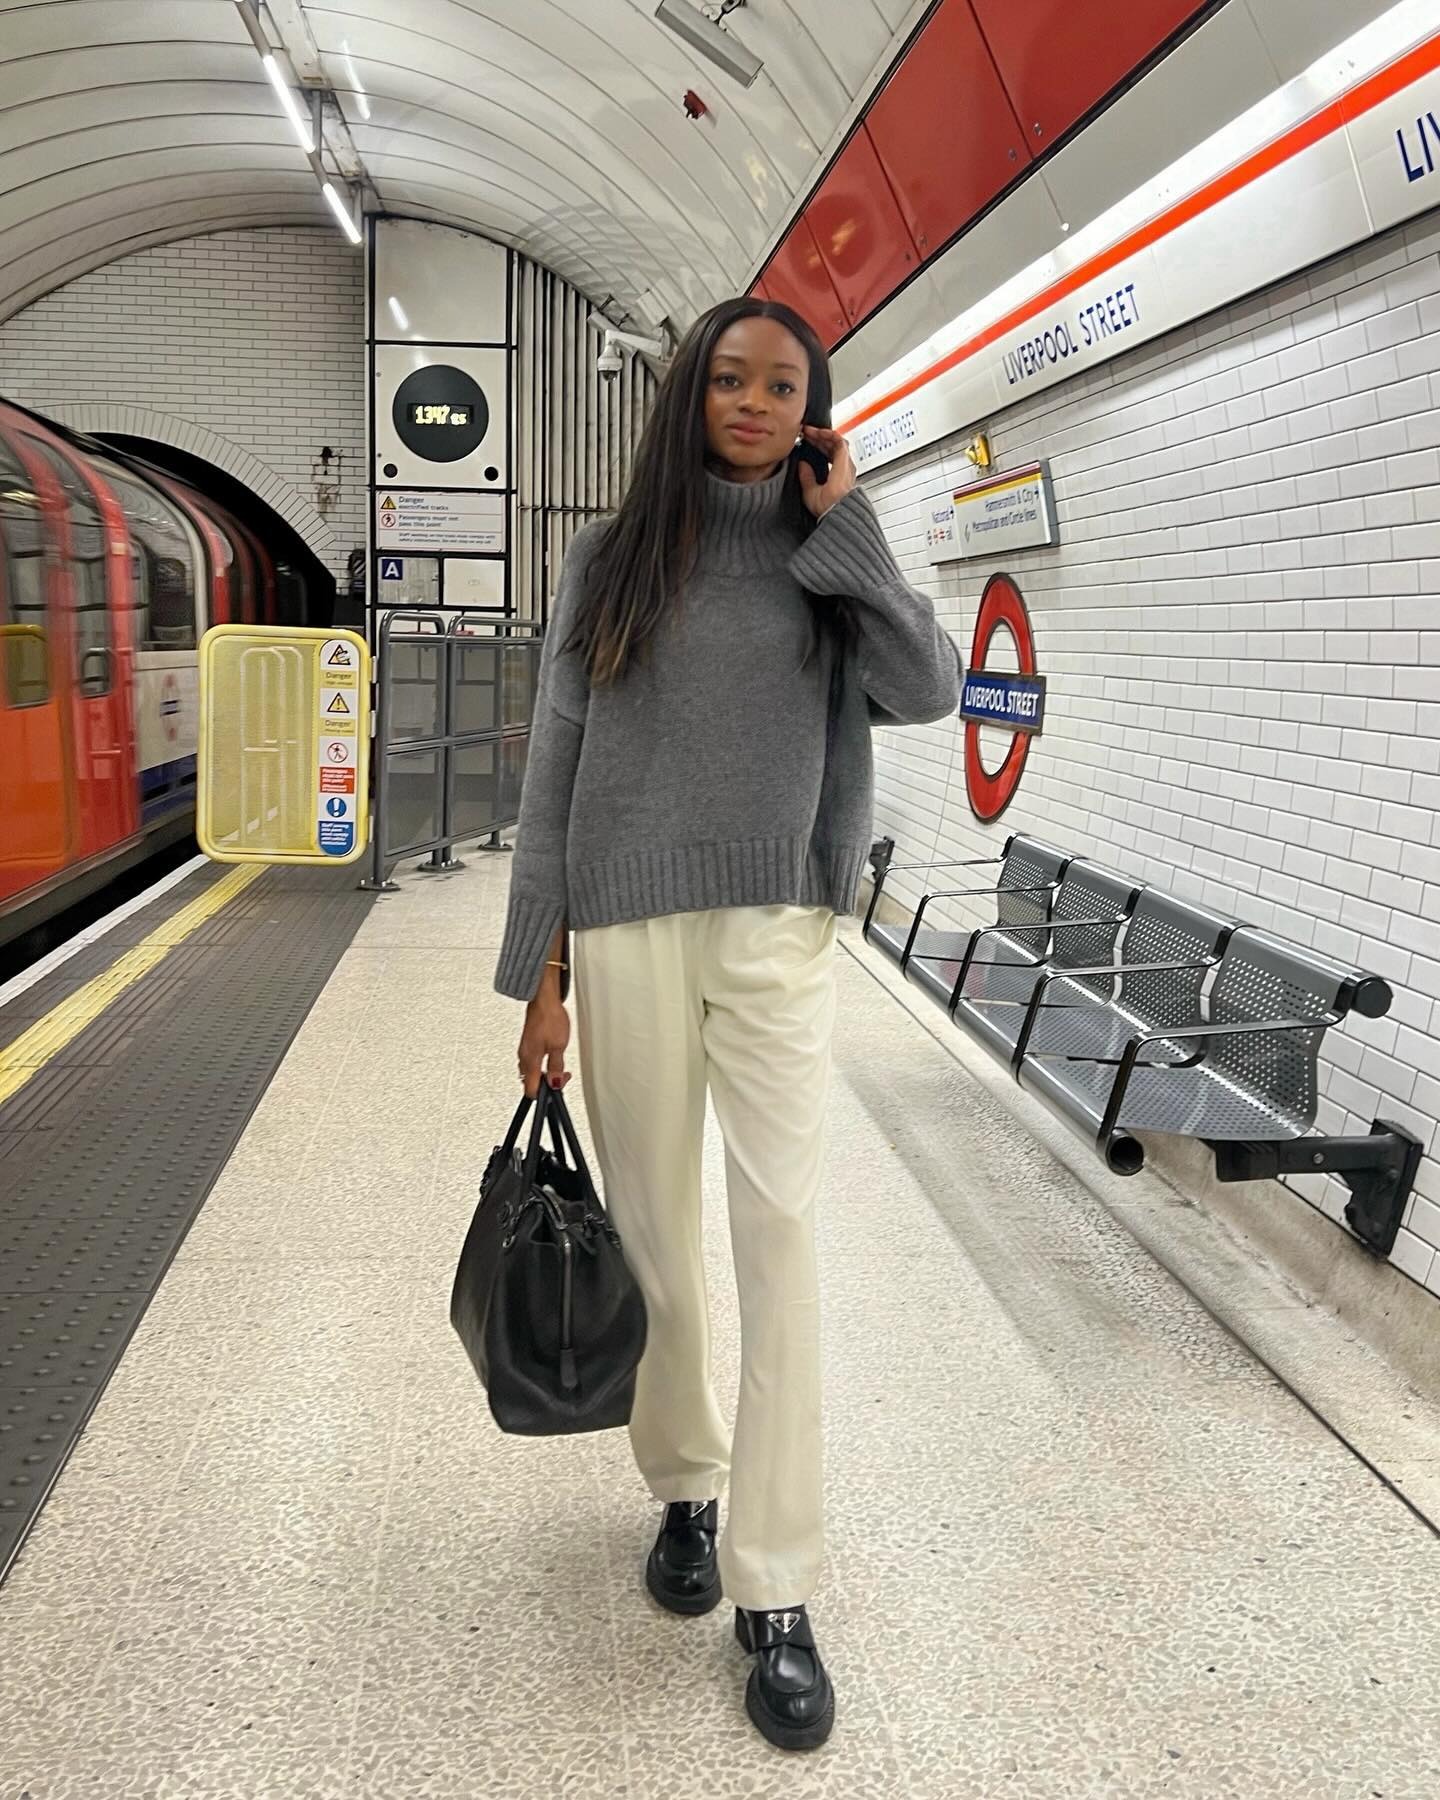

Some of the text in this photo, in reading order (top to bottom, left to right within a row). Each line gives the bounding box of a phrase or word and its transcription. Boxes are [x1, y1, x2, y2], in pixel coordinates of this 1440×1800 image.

[1002, 284, 1139, 384] LIVERPOOL STREET
[415, 405, 450, 425] 1347
[855, 410, 917, 460] LIVERPOOL STREET
[399, 496, 424, 504] Danger
[384, 561, 399, 577] A
[326, 672, 352, 680] Danger
[965, 686, 1039, 717] LIVERPOOL STREET
[325, 720, 351, 728] Danger
